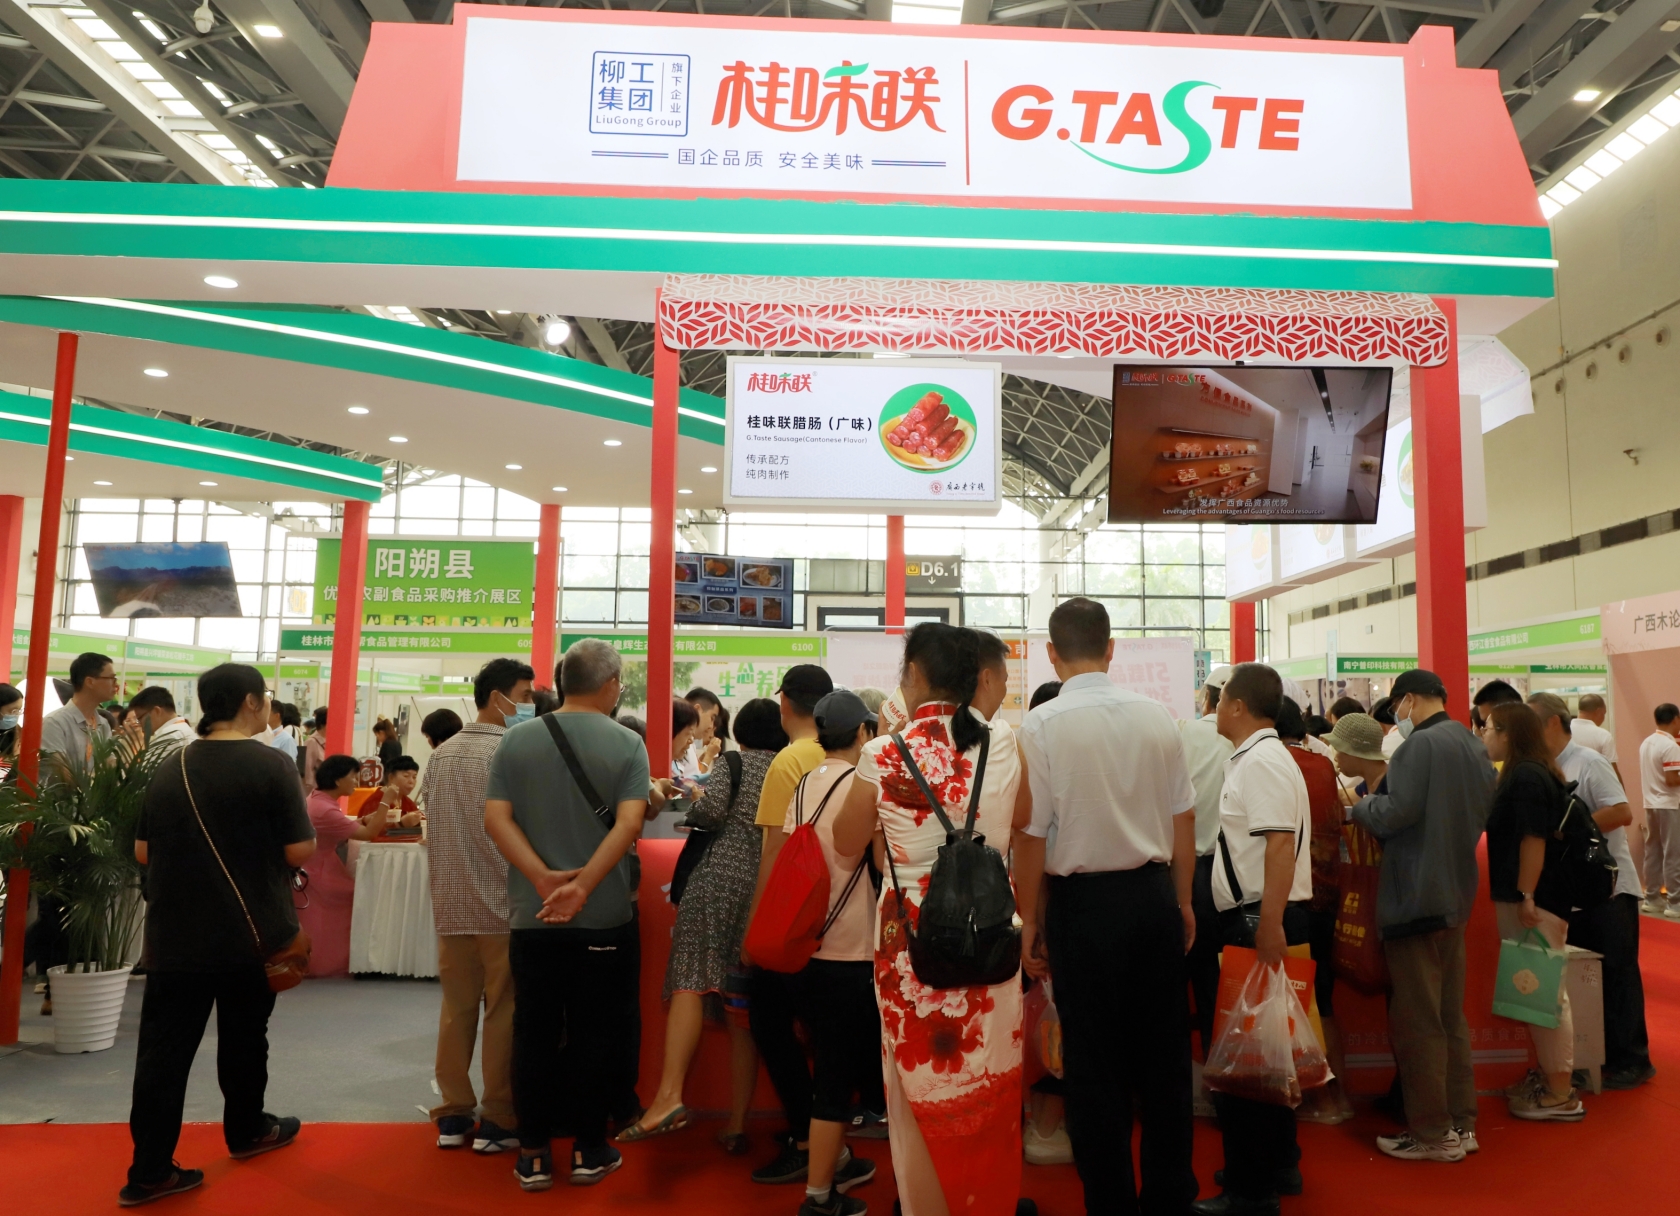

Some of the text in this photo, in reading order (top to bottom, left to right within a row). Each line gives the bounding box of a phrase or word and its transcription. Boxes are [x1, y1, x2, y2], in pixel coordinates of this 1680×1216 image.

[599, 59, 654, 83] 柳工
[669, 62, 683, 113] 旗下企业
[597, 86, 653, 112] 集团
[711, 60, 947, 136] 桂味联
[595, 115, 682, 129] LiuGong Group
[991, 80, 1305, 174] G.TASTE
[677, 148, 864, 171] 国企品质 安全美味
[747, 372, 813, 394] 桂味联
[746, 434, 772, 442] G.Taste
[745, 454, 789, 465] 传承配方
[745, 469, 789, 480] 纯肉制作
[1199, 498, 1289, 507] 发挥广西食品资源优势
[1162, 508, 1196, 516] Leveraging
[1208, 508, 1243, 516] advantages
[1250, 508, 1280, 516] Guangxi's
[374, 548, 475, 579] 阳朔县
[921, 561, 958, 577] D6.1
[323, 585, 521, 604] 优农副食品采购推介展区
[1579, 623, 1595, 635] 6187
[791, 642, 814, 652] 6100
